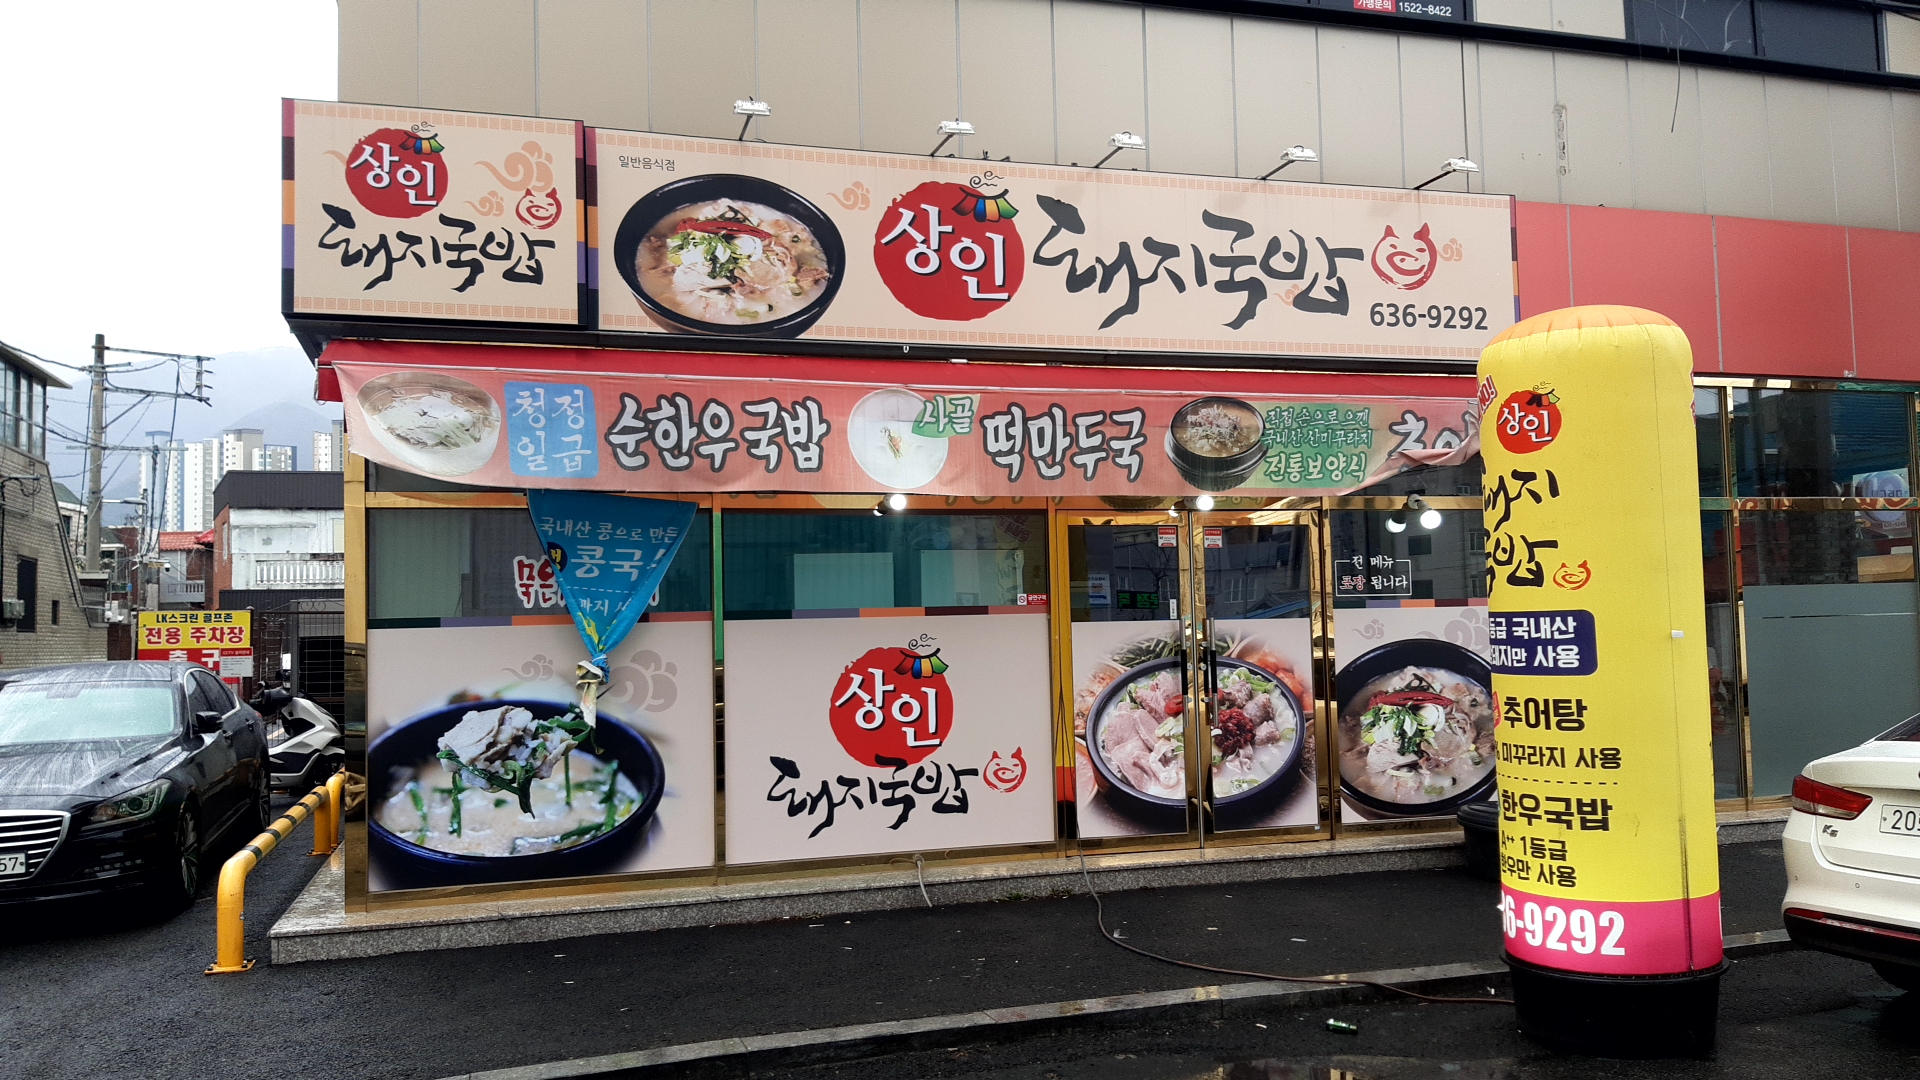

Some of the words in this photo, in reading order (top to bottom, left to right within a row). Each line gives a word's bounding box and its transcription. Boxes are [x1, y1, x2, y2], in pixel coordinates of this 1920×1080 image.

[1398, 2, 1452, 17] 1522-8422
[350, 141, 440, 207] 상인
[618, 155, 675, 172] 일반음식점
[317, 203, 556, 292] 돼지국밥
[881, 202, 1011, 301] 상인
[1033, 194, 1364, 330] 돼지국밥
[1368, 302, 1490, 330] 636-9292
[512, 386, 586, 431] 청정
[1267, 408, 1295, 427] 직접
[1296, 410, 1339, 426] 손으로
[1498, 402, 1553, 442] 상인
[919, 396, 973, 434] 사골
[980, 402, 1147, 483] 떡만두국
[1262, 430, 1302, 448] 국내산
[516, 435, 592, 473] 일급
[539, 516, 591, 539] 국내산
[597, 522, 644, 541] 콩으로
[650, 527, 679, 544] 만든
[1351, 555, 1363, 570] 전
[1369, 555, 1394, 570] 메뉴
[1339, 575, 1366, 591] 포장
[1370, 575, 1408, 590] 됩니다
[156, 613, 199, 624] LK스크린
[203, 612, 234, 624] 골프존
[1512, 616, 1577, 640] 국내산
[145, 626, 182, 645] 전용
[190, 626, 245, 645] 주차장
[1533, 645, 1580, 668] 사용
[834, 667, 942, 747] 상인
[1503, 696, 1588, 732] 추어탕
[1502, 742, 1566, 769] 미꾸라지
[1575, 747, 1622, 770] 사용
[767, 753, 978, 839] 돼지국밥
[1501, 789, 1613, 832] 한우국밥
[1520, 836, 1568, 861] 1등급
[1537, 863, 1577, 888] 사용
